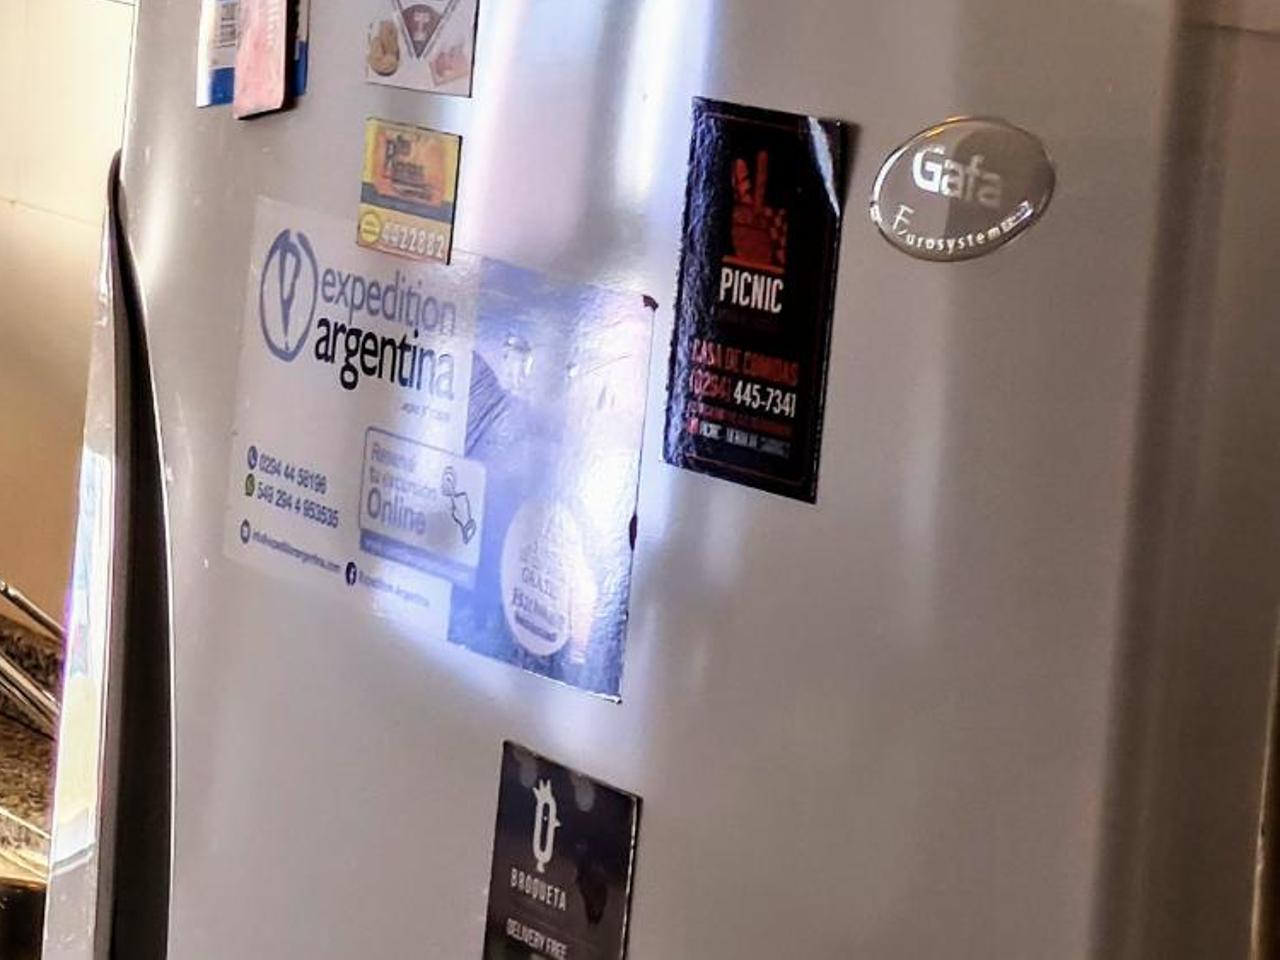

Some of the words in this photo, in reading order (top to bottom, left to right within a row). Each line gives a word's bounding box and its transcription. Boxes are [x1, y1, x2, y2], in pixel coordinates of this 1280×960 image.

[912, 145, 1001, 210] Gafa
[321, 268, 456, 336] expedition
[720, 266, 785, 314] PICNIC
[315, 317, 455, 401] argentina
[733, 380, 797, 419] 445-7341
[367, 486, 427, 536] Online
